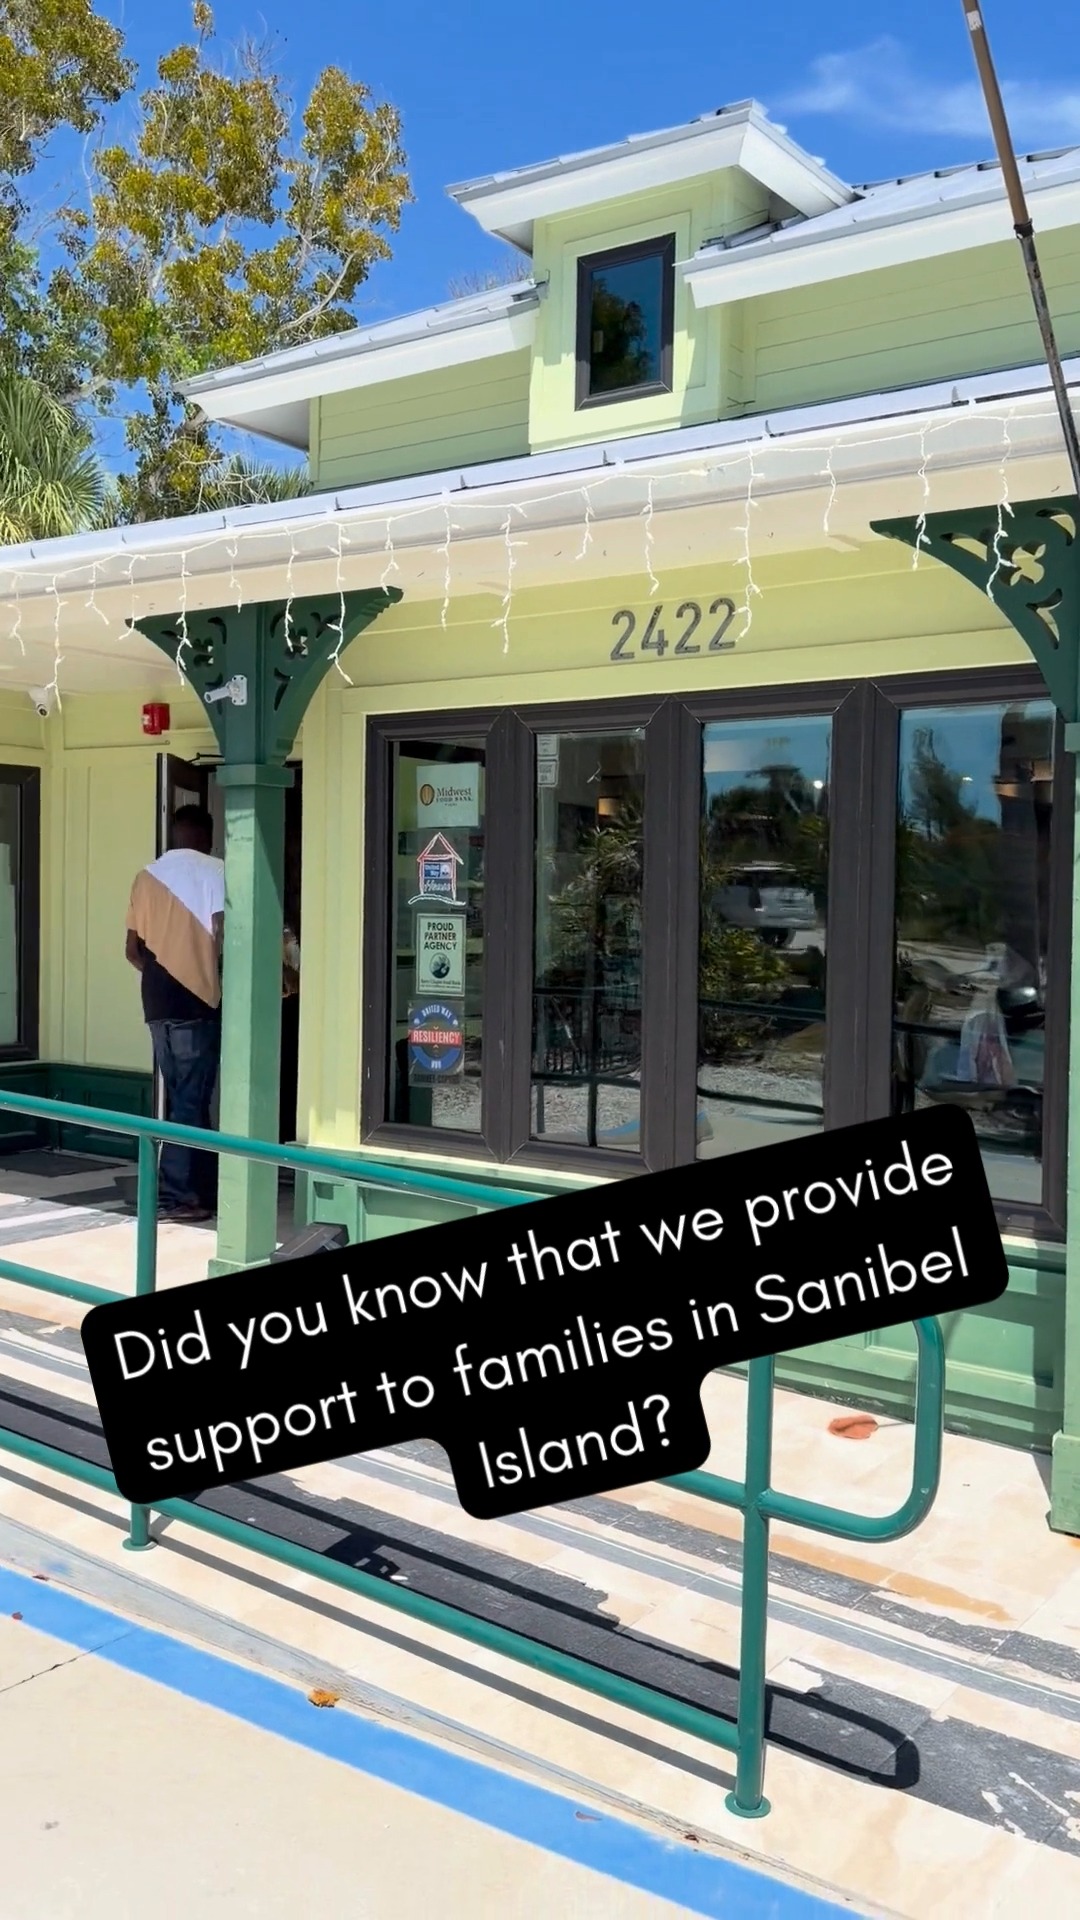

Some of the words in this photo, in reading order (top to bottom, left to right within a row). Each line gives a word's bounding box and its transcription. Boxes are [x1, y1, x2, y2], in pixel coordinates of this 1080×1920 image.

[610, 597, 736, 661] 2422
[436, 786, 472, 797] Midwest
[427, 922, 454, 931] PROUD
[424, 932, 457, 941] PARTNER
[423, 941, 458, 950] AGENCY
[413, 1030, 461, 1044] RESILIENCY
